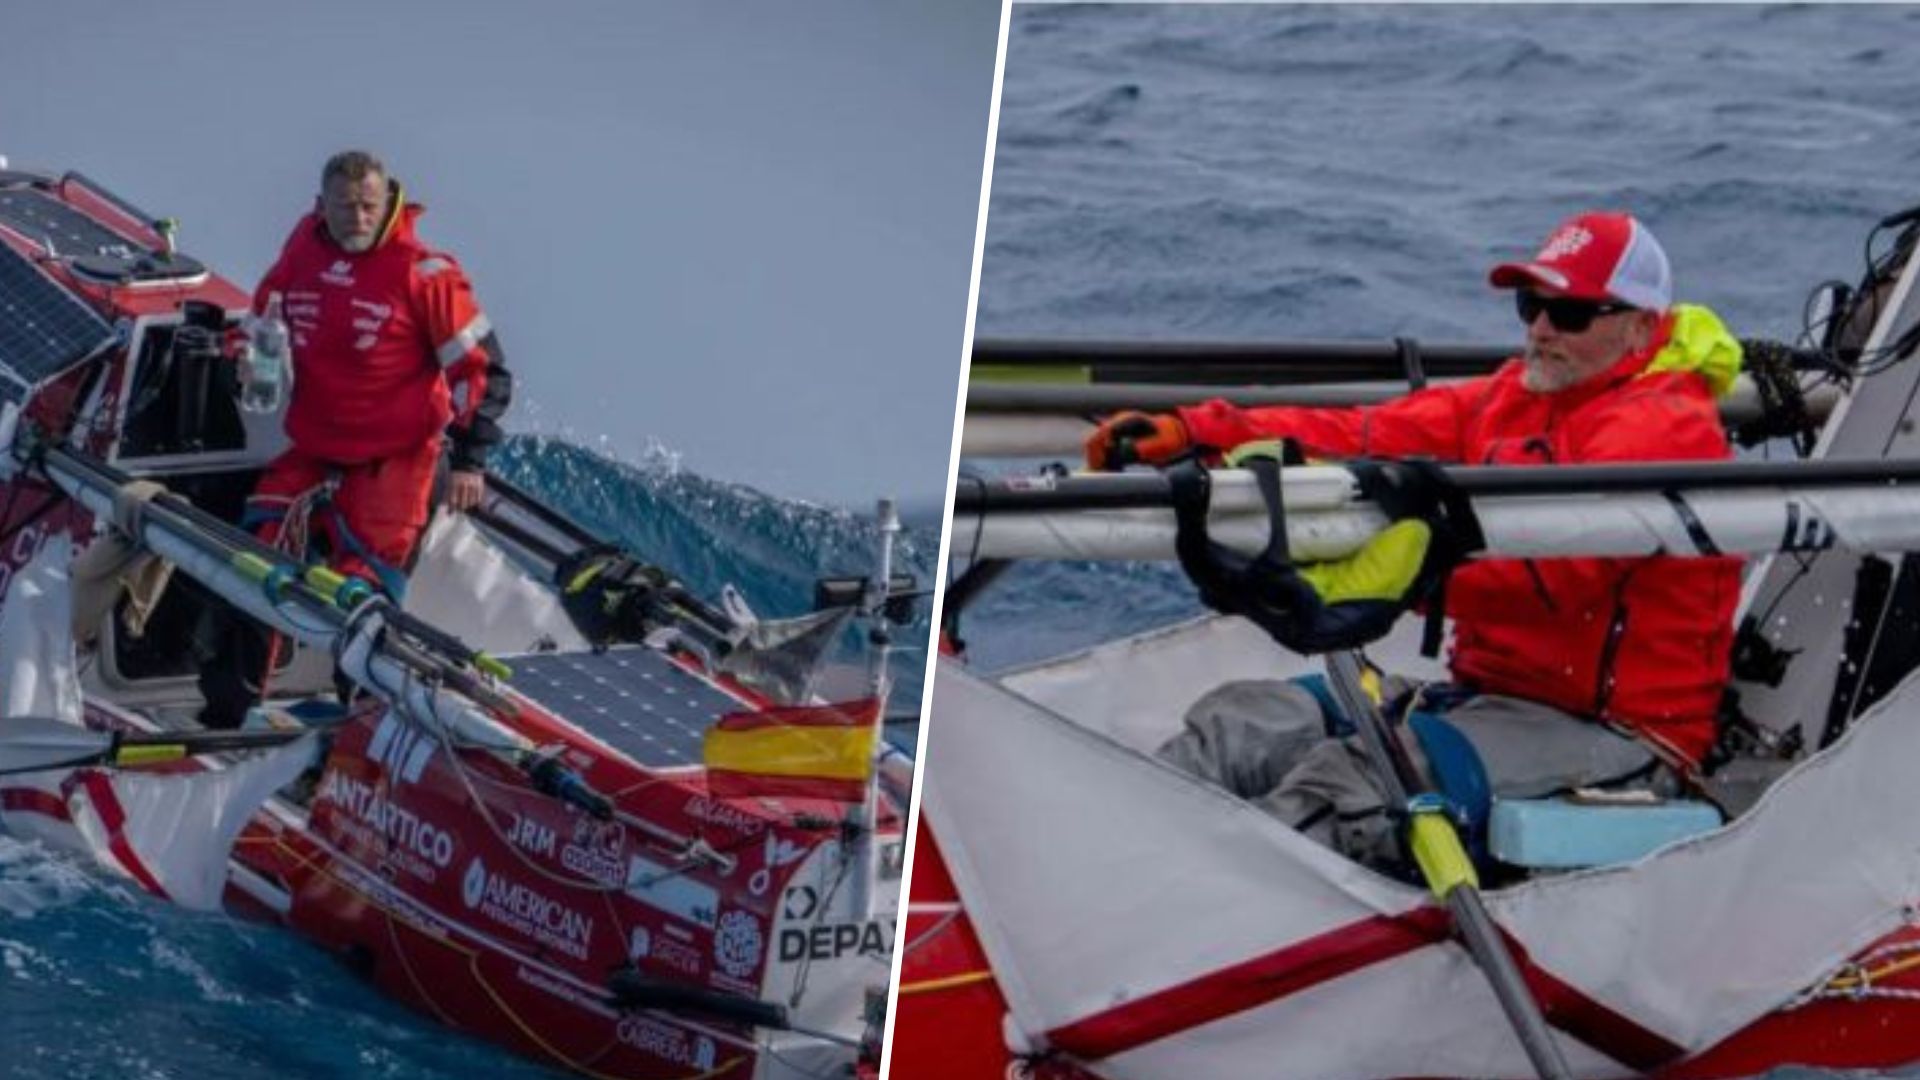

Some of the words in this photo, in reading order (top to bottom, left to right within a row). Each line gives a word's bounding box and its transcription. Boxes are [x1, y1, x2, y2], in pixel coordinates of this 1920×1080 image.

[507, 811, 556, 859] JRM
[485, 872, 593, 943] AMERICAN
[780, 920, 897, 962] DEPA
